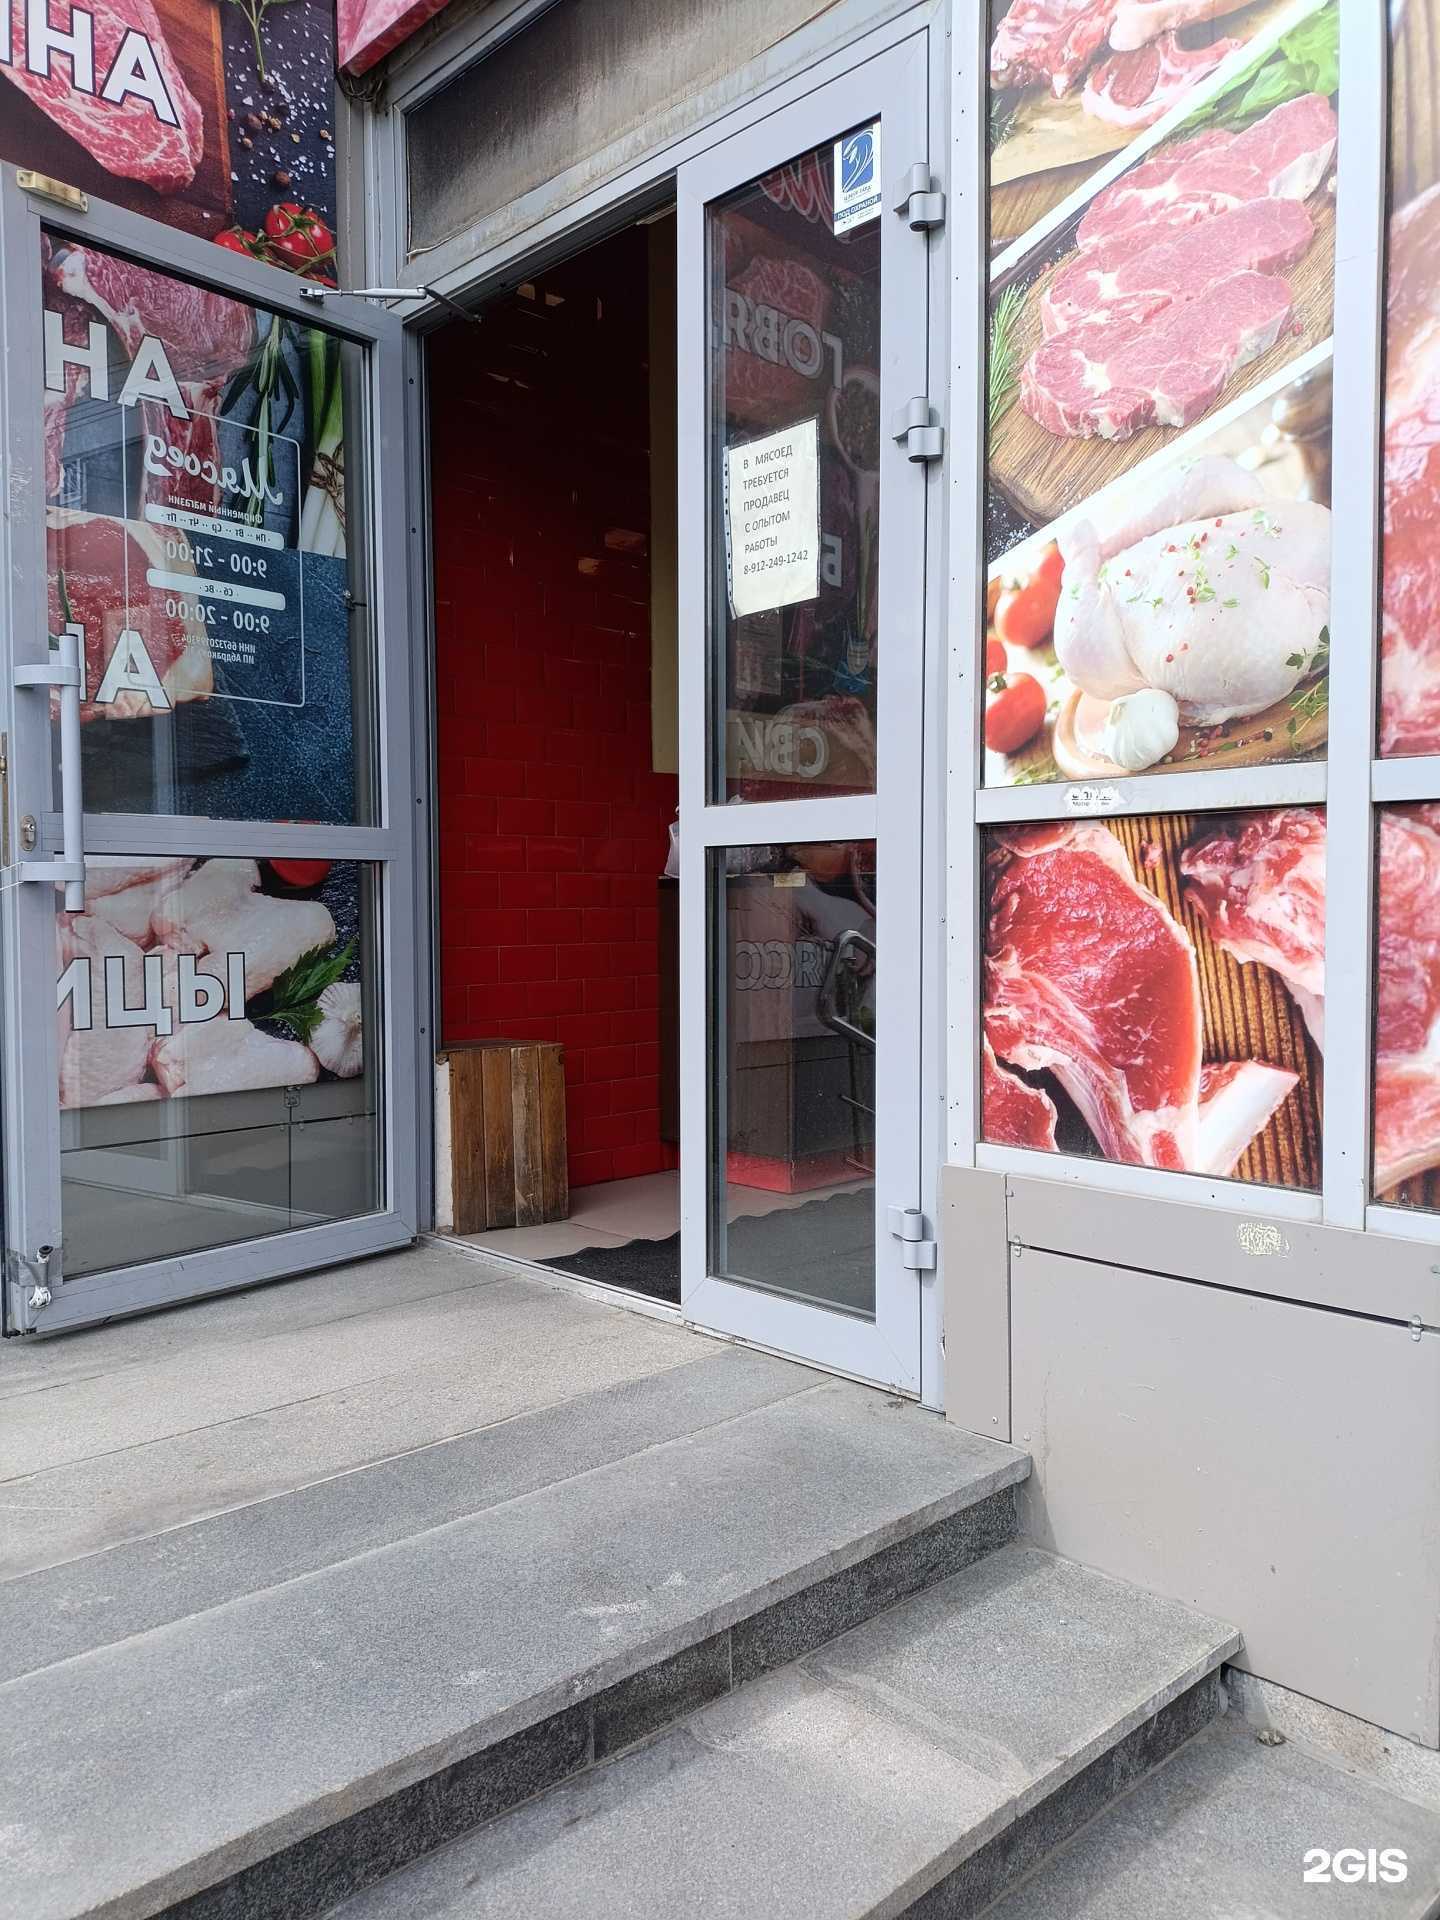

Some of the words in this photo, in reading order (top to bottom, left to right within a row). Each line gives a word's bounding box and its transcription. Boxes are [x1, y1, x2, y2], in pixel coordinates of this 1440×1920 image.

[0, 0, 181, 129] НА
[743, 458, 749, 469] В
[755, 444, 793, 466] МЯСОЕД
[743, 468, 789, 490] ТРЕБУЕТСЯ
[743, 489, 790, 512] ПРОДАВЕЦ
[744, 521, 751, 533] С
[752, 510, 791, 532] ОПЫТОМ
[744, 535, 778, 554] РАБОТЫ
[743, 549, 809, 576] 8-912-249-1242
